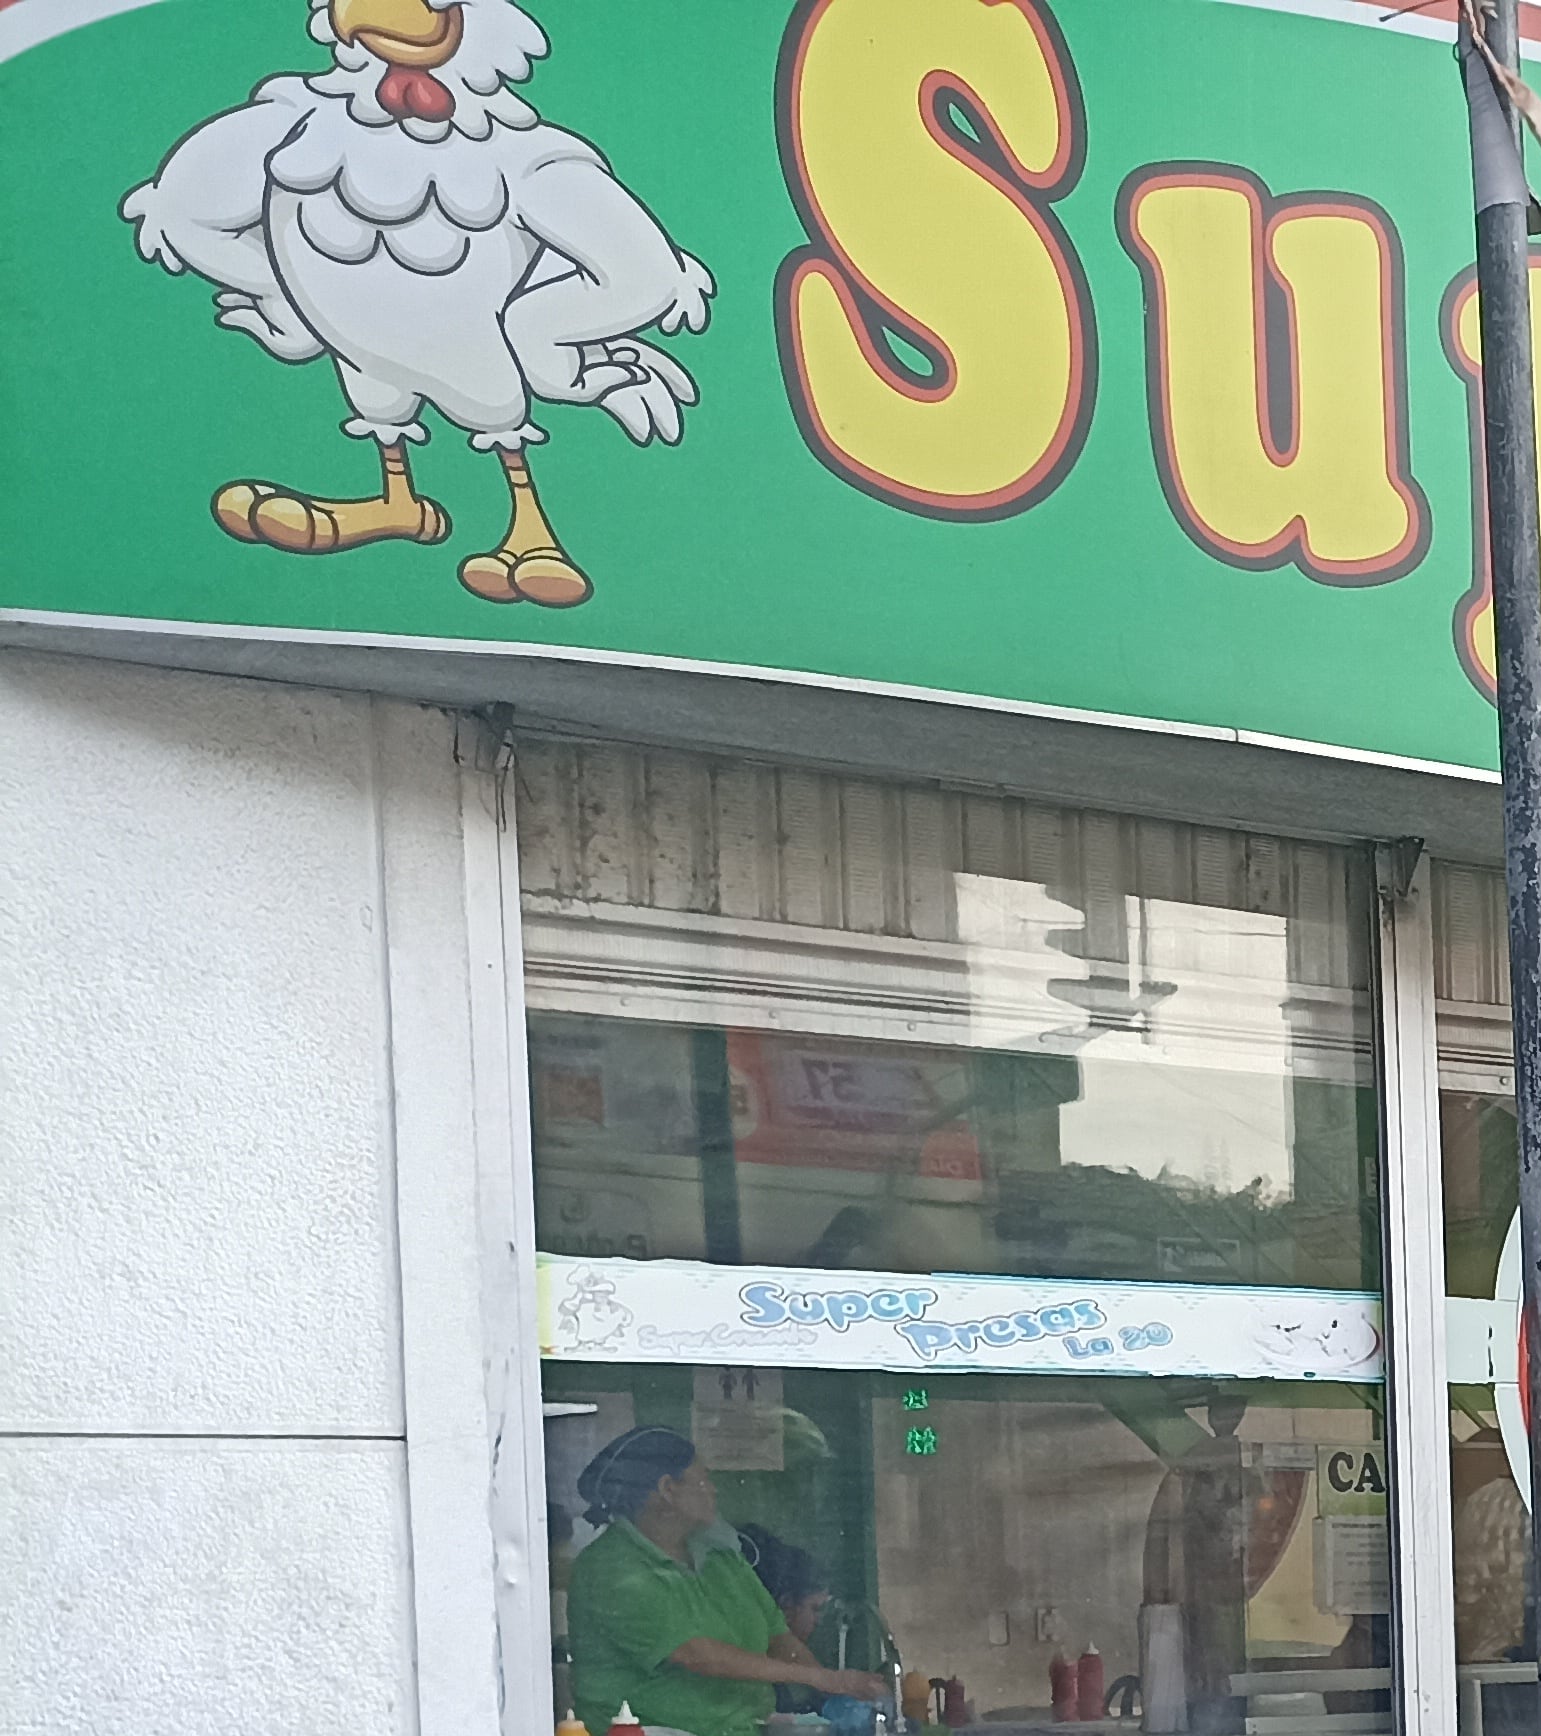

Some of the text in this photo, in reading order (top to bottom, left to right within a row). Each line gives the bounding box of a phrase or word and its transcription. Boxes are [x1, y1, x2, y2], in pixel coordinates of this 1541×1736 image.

[739, 1281, 1107, 1362] Super presas
[1063, 1321, 1174, 1360] La 20
